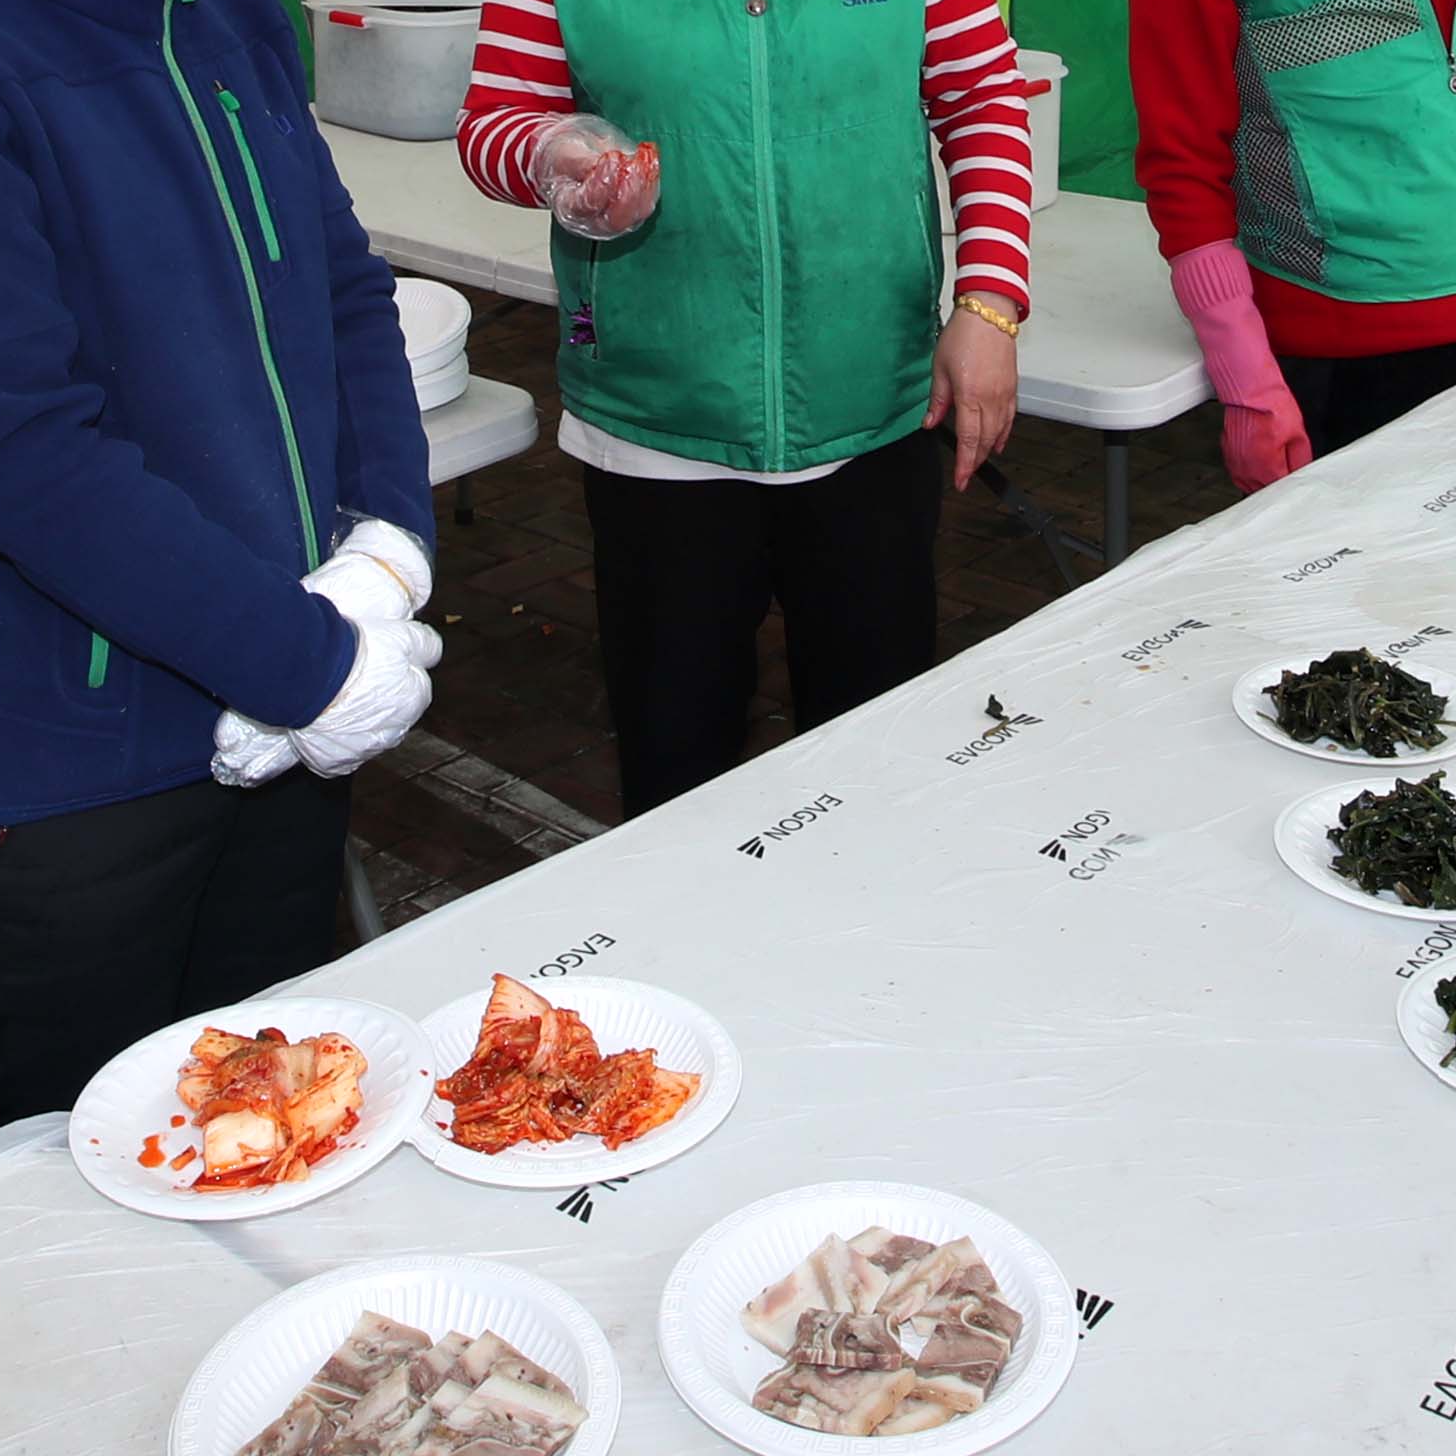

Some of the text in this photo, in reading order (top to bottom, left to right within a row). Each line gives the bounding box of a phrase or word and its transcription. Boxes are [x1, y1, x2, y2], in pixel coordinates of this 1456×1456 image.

[762, 793, 844, 841] EAGON
[1059, 809, 1111, 844] GON
[528, 932, 617, 978] EAGO
